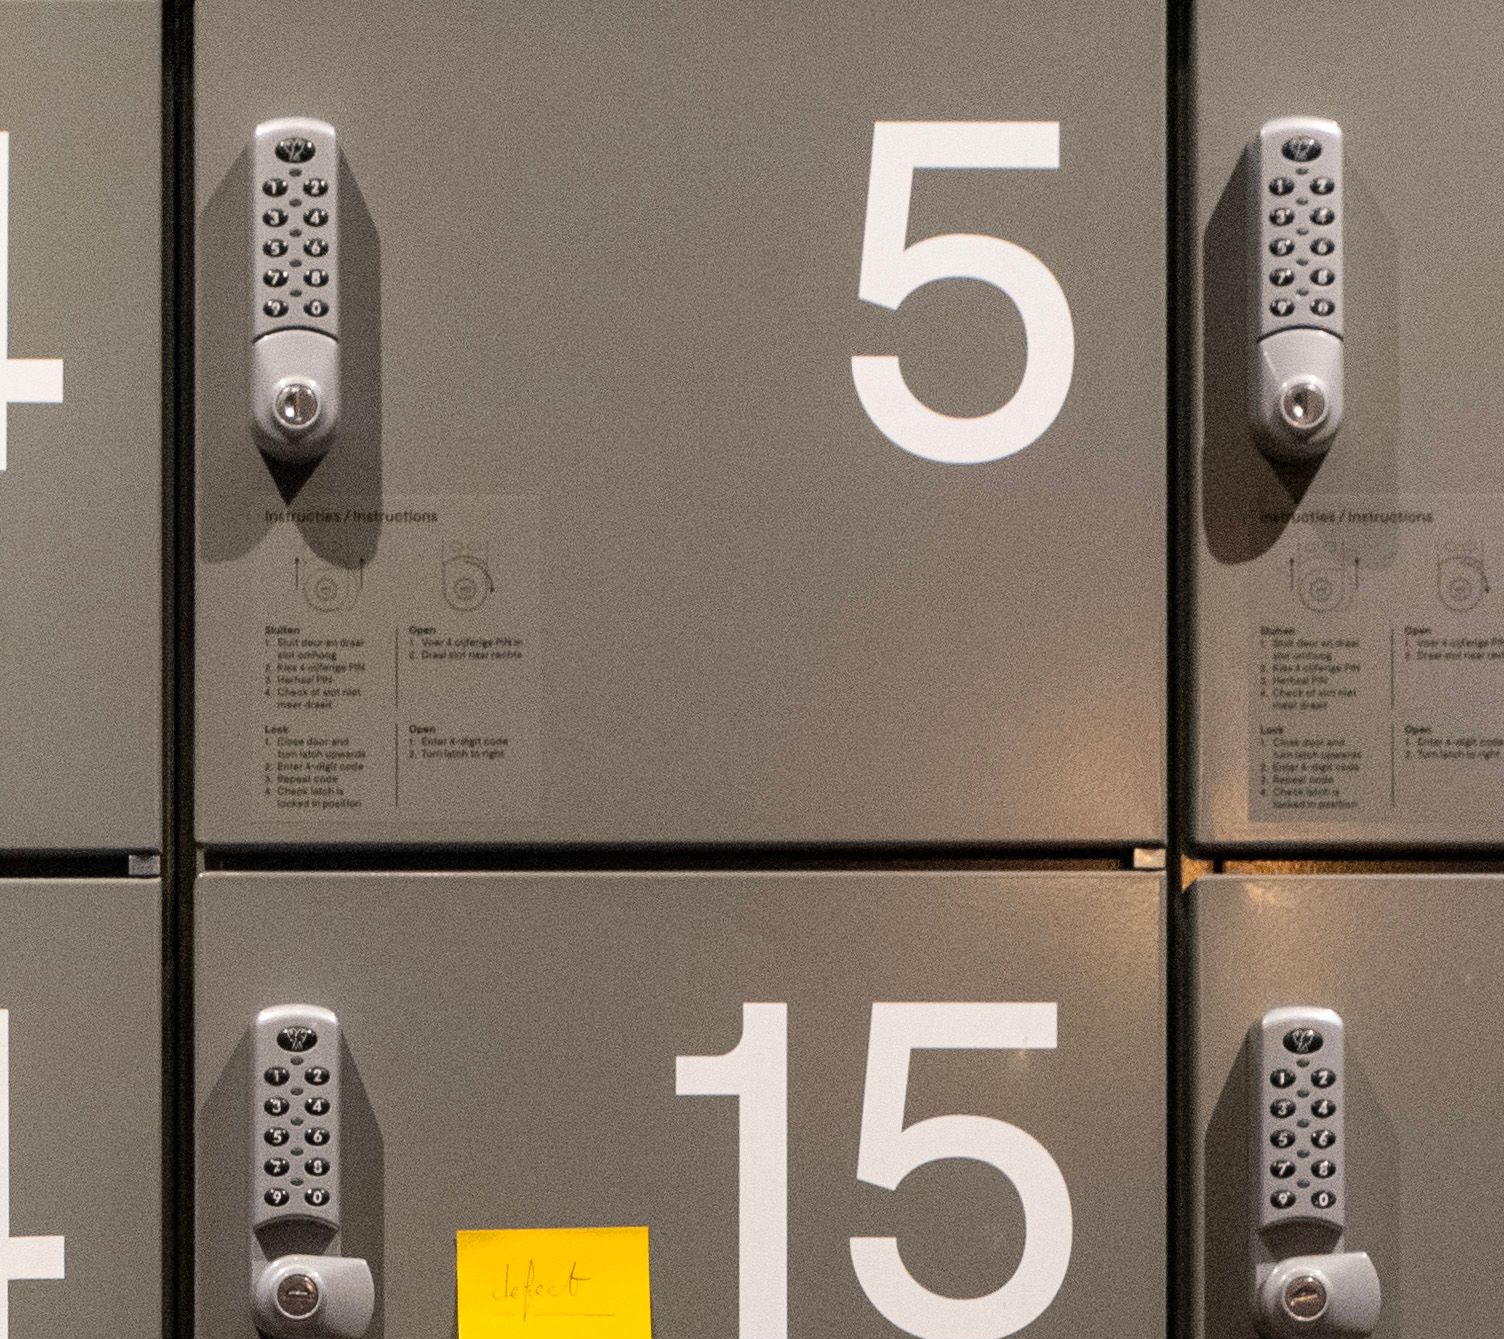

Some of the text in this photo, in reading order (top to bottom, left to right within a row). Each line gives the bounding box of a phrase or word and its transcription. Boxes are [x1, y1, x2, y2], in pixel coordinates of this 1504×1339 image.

[851, 121, 1075, 464] 5
[353, 511, 438, 522] Instructions
[492, 1259, 590, 1321] defect
